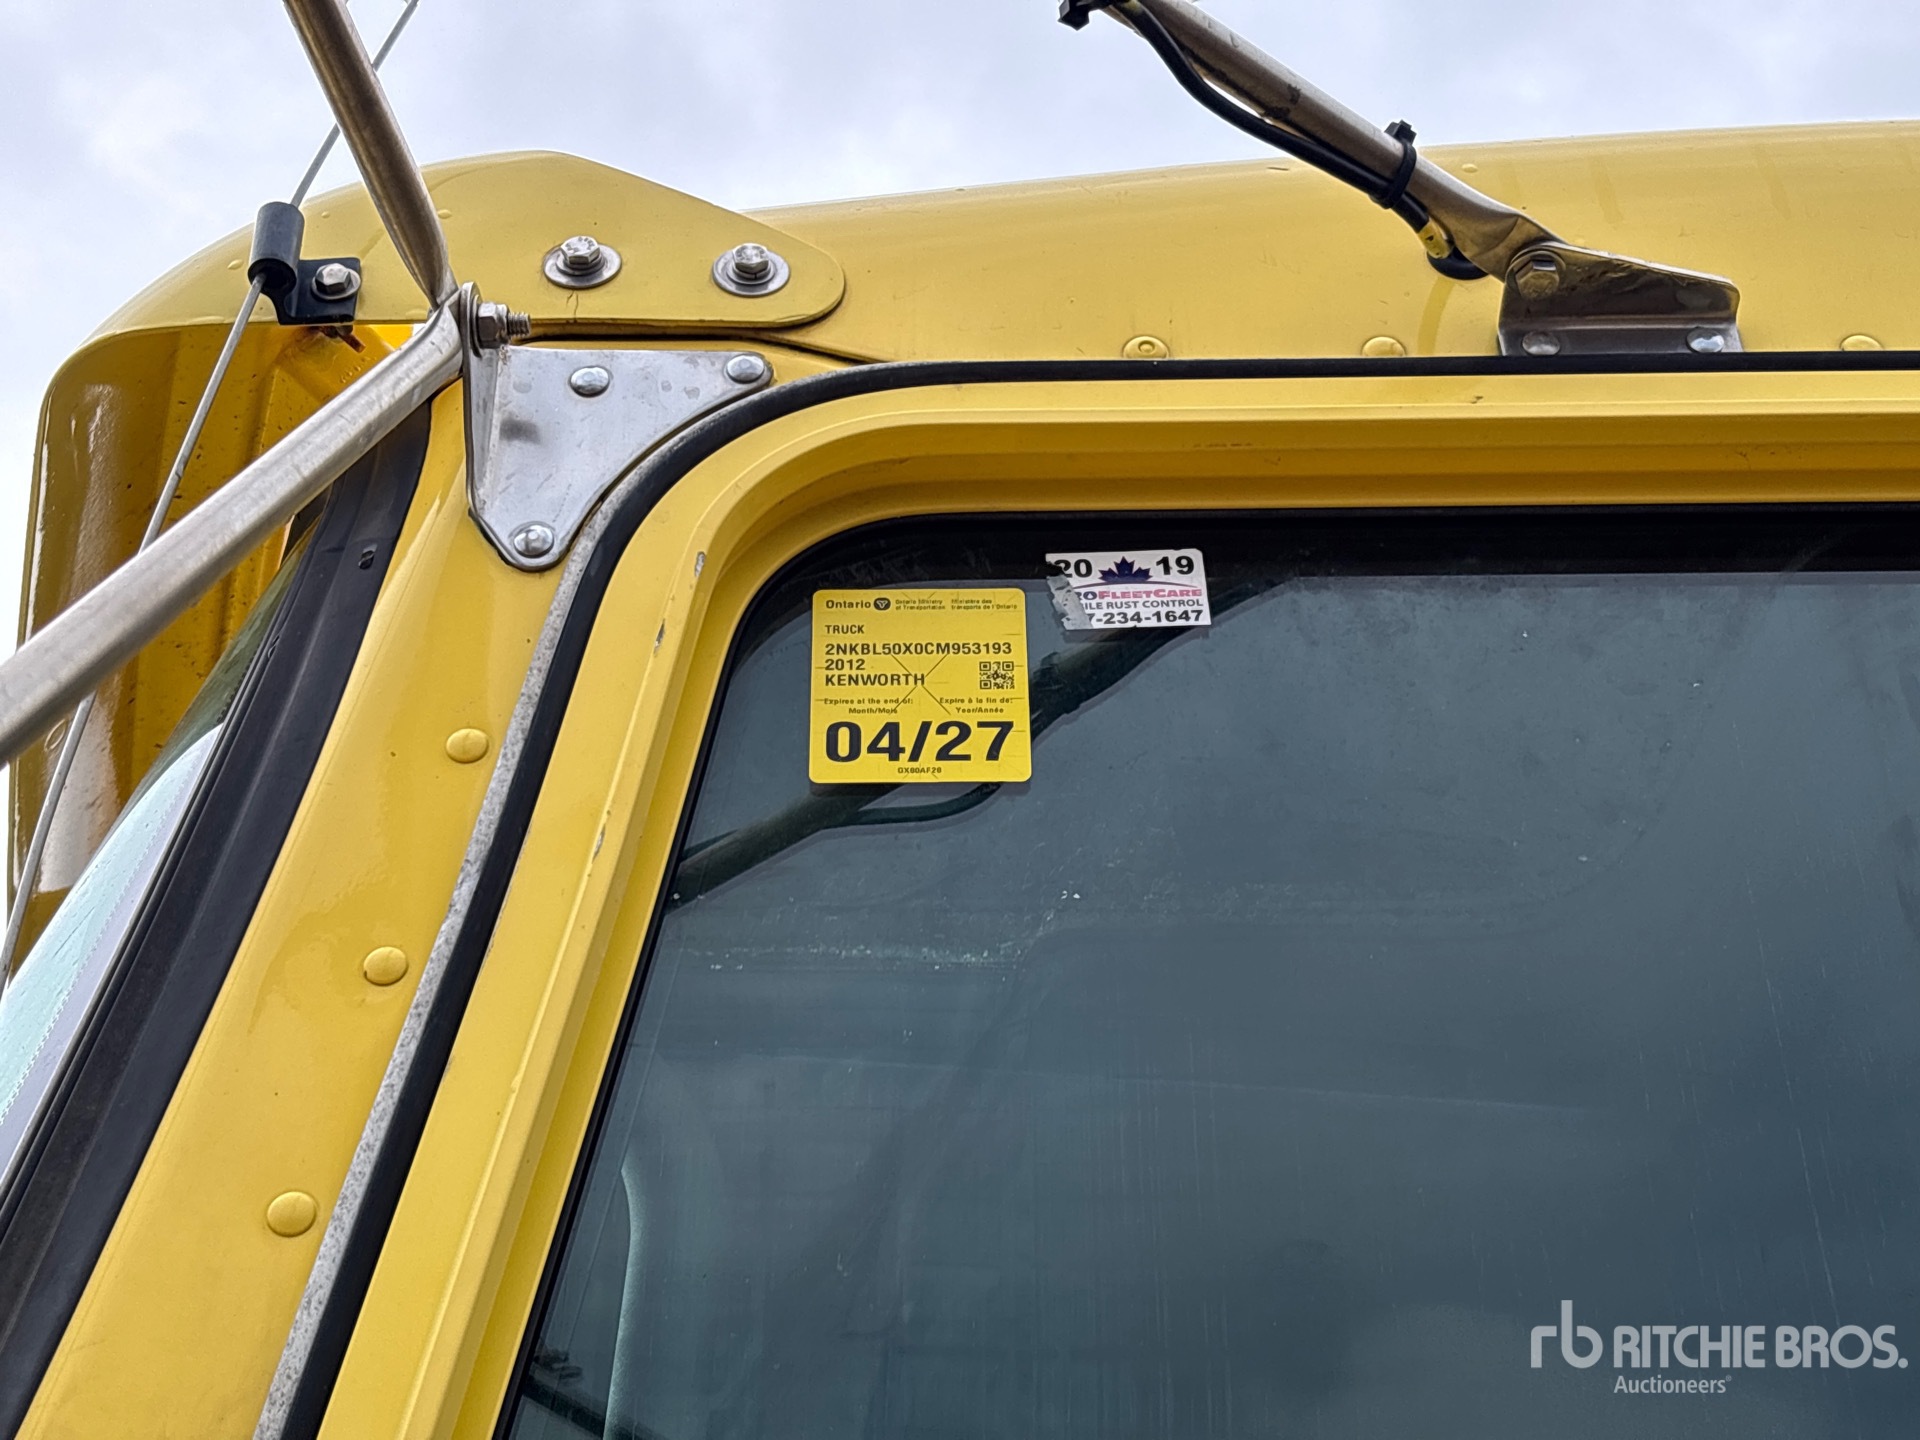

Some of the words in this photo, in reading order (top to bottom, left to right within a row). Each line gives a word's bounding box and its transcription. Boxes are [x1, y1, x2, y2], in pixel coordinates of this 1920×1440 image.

[1054, 559, 1093, 578] 20
[1156, 555, 1195, 576] 19
[825, 599, 872, 609] Ontario
[1106, 599, 1140, 609] RUST
[1141, 597, 1204, 608] CONTROL
[825, 624, 865, 634] TRUCK
[825, 642, 1012, 656] 2NKBL50X0CM953193
[825, 658, 866, 671] 2012
[825, 673, 925, 687] KENWORTH
[824, 698, 855, 706] Expires
[940, 697, 965, 705] Expire
[955, 706, 1004, 714] Year/Année
[825, 720, 1015, 763] 04/27
